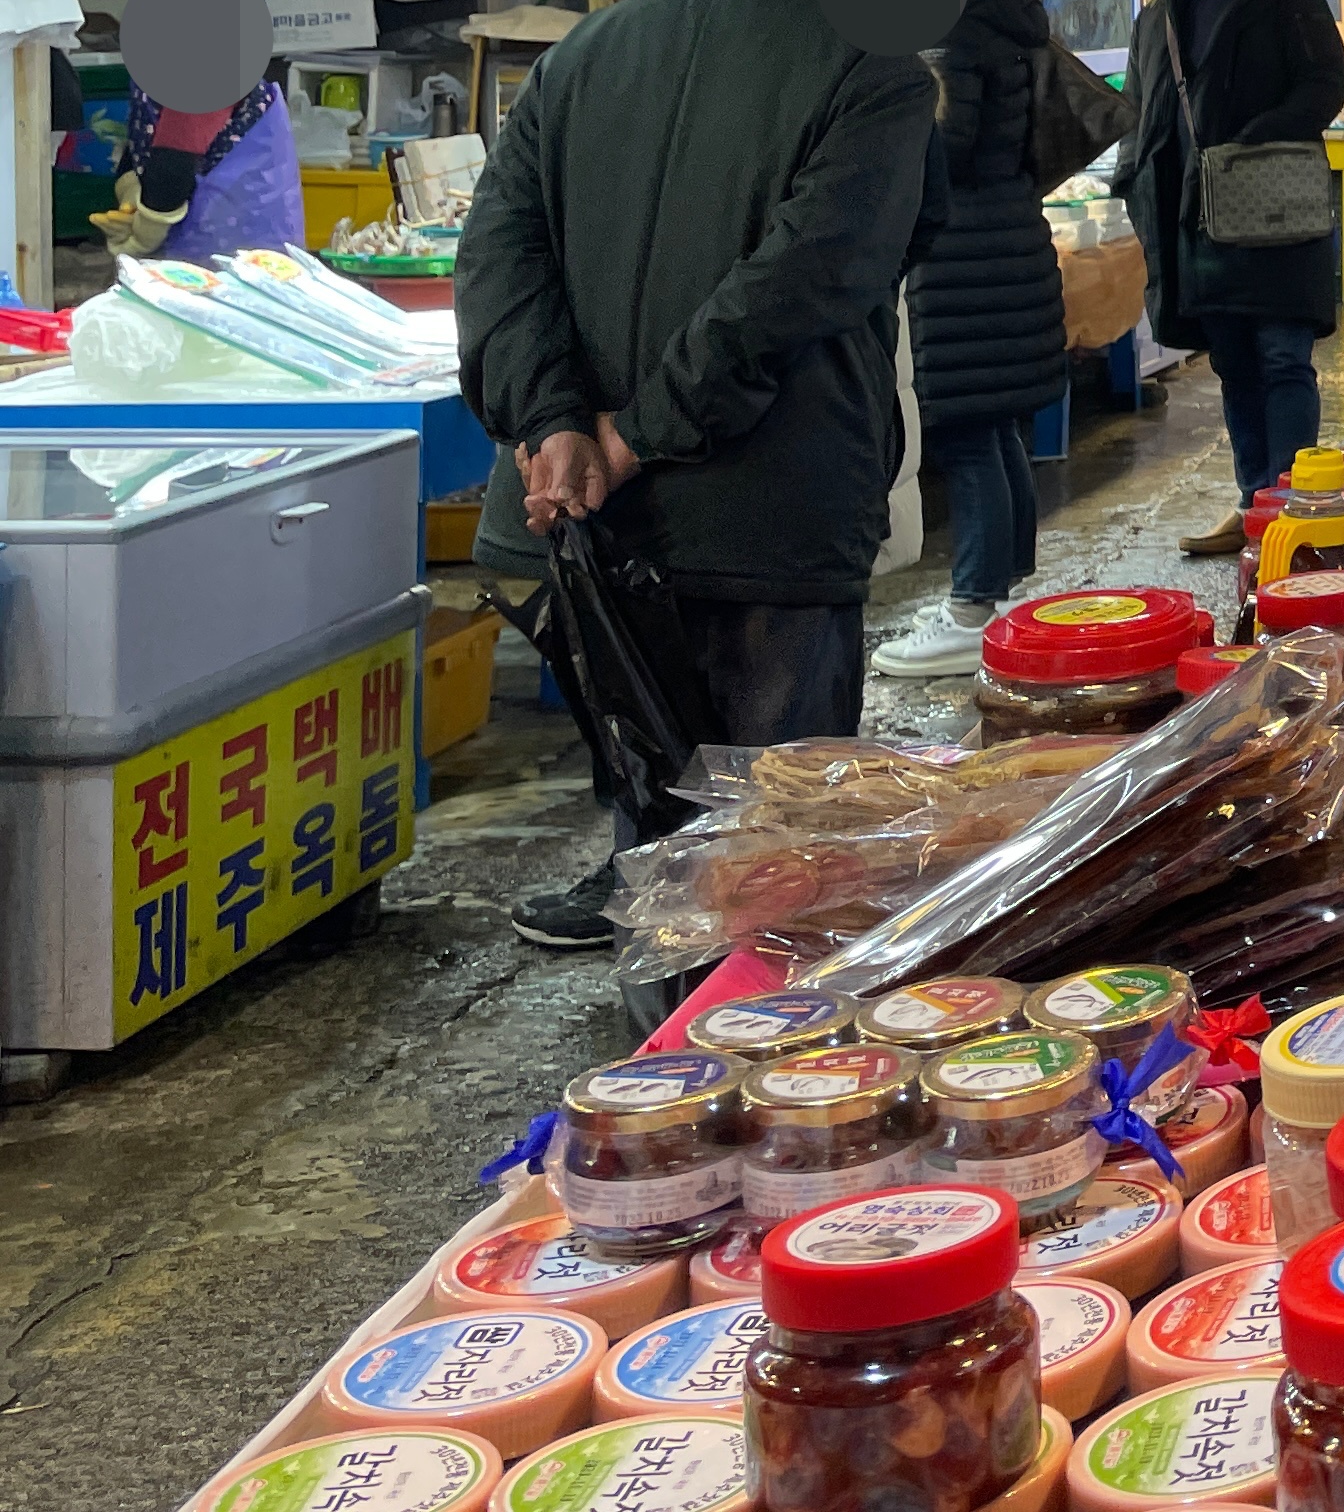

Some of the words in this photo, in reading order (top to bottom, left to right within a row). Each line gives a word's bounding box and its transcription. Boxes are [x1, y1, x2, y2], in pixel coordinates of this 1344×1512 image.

[133, 657, 404, 890] 전국택배
[128, 764, 401, 1007] 제주옥돔
[1070, 1293, 1106, 1327] 30년전통
[544, 1325, 577, 1357] 30년전통
[411, 1348, 493, 1403] 자리젓
[504, 1357, 570, 1392] 제주젓갈
[430, 1444, 469, 1479] 30년전통
[1172, 1388, 1249, 1488] 갈치속젓
[311, 1443, 399, 1512] 갈치속
